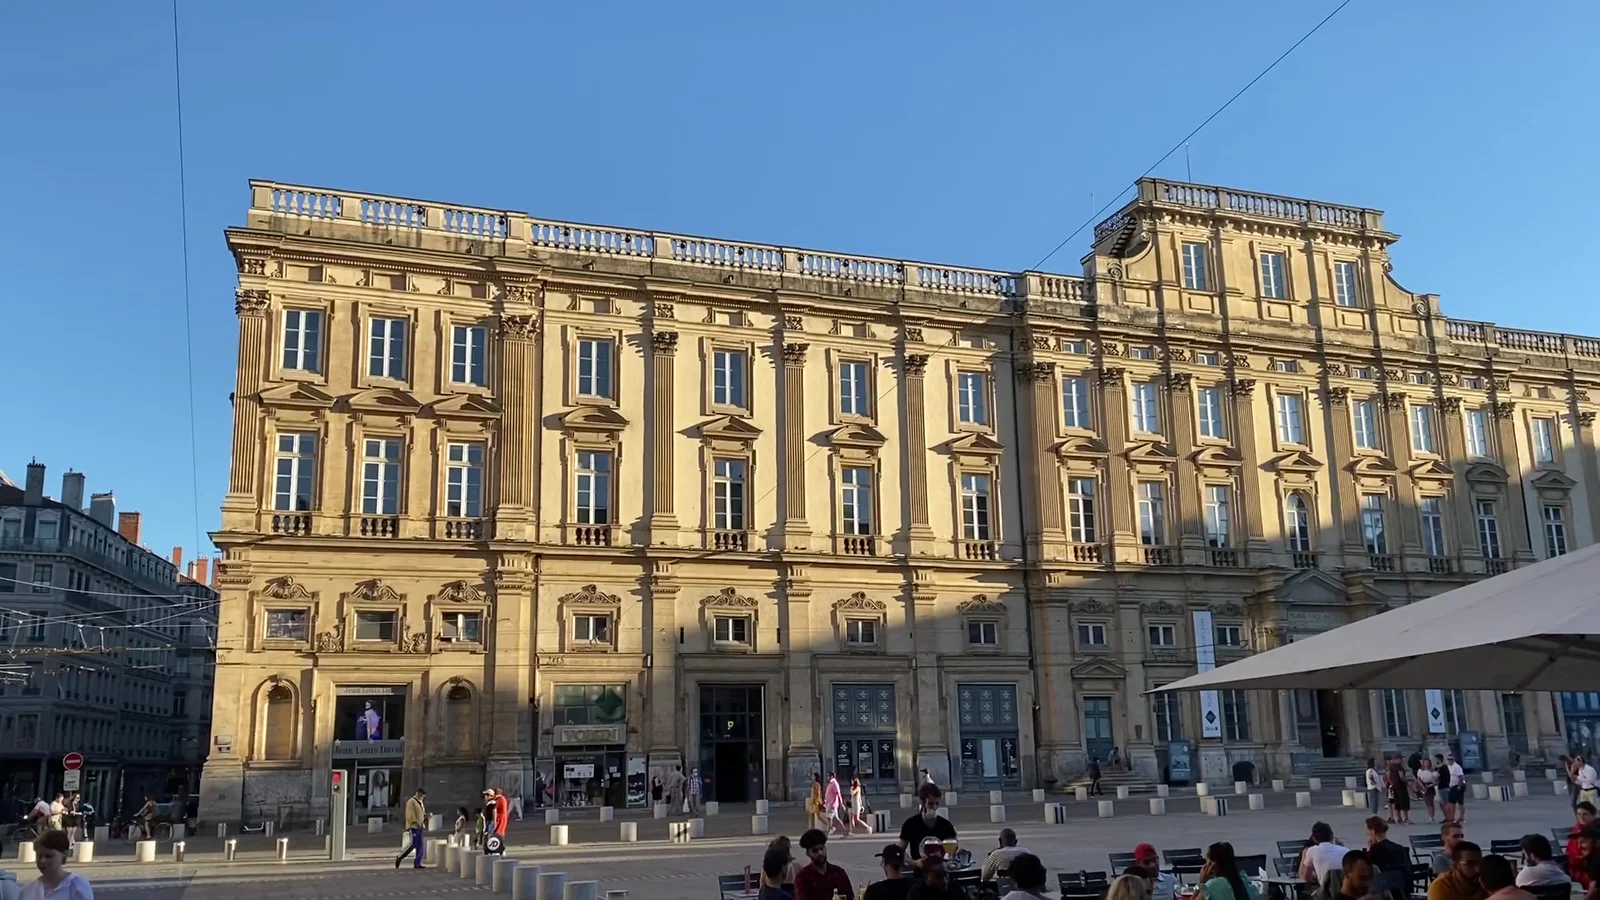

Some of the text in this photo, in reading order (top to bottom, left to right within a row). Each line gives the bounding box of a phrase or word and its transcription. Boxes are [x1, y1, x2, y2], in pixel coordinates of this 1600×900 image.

[333, 744, 403, 755] Jean Louis David
